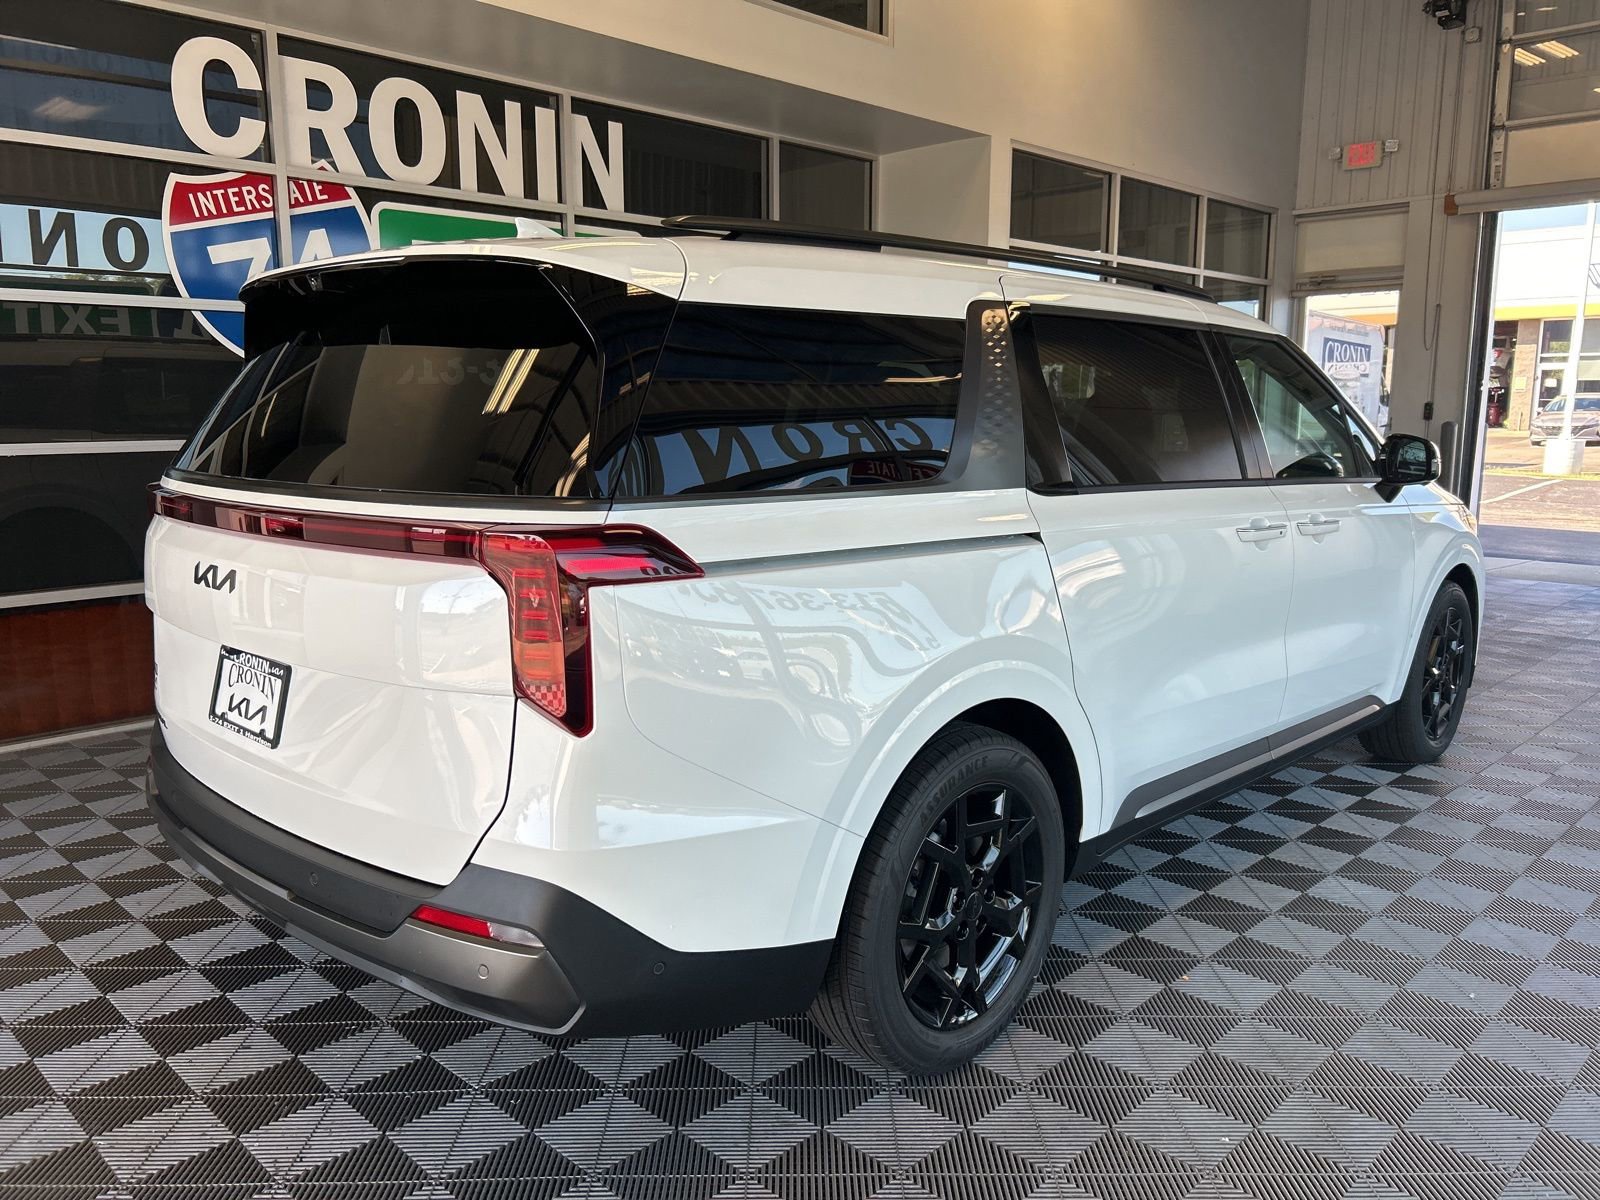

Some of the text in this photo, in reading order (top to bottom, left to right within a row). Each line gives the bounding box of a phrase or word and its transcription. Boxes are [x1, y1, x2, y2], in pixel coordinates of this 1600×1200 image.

[171, 36, 625, 213] CRONIN
[188, 180, 329, 218] INTERSATE
[1325, 341, 1369, 362] CRONIN
[193, 560, 237, 594] KIA
[228, 663, 277, 705] CRONIN
[227, 692, 268, 726] KIA
[919, 755, 990, 827] ASSURANCE
